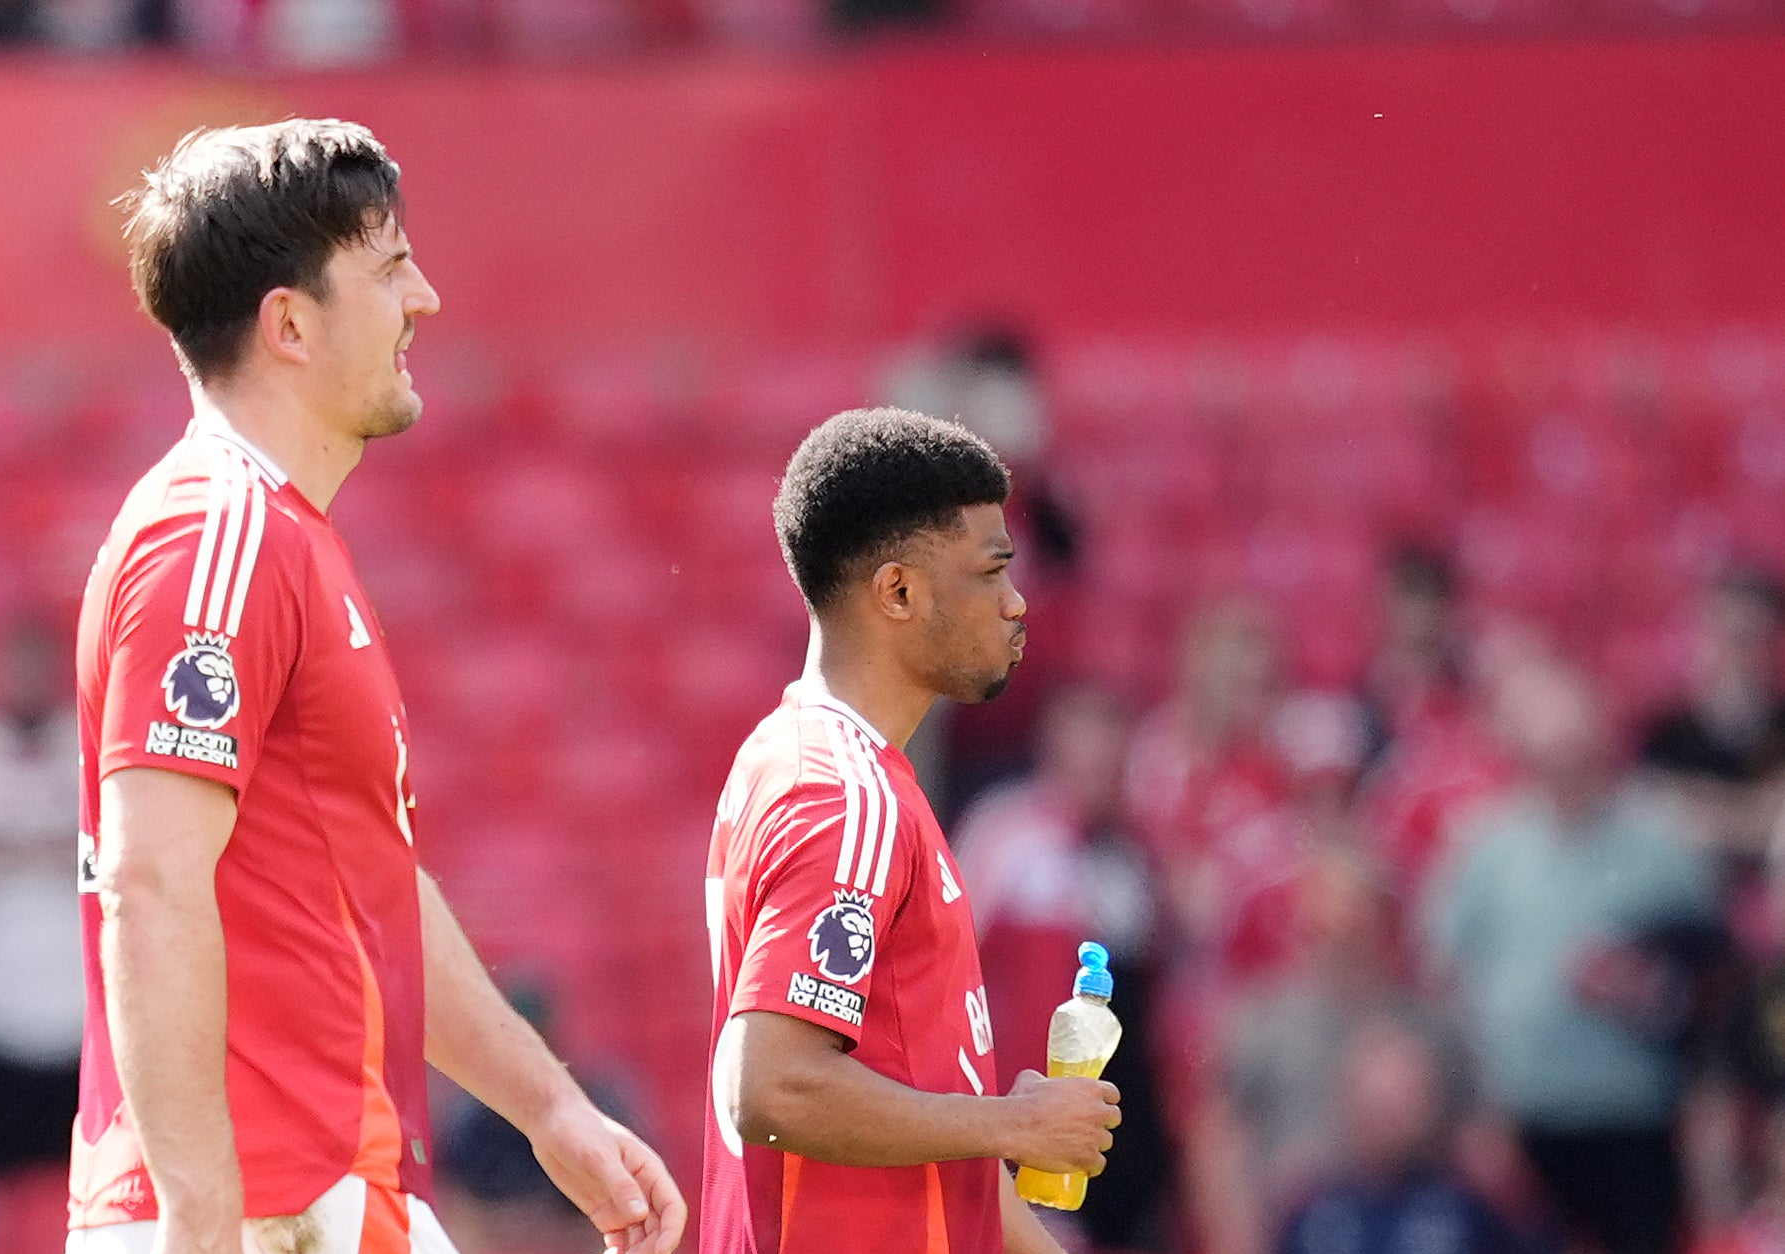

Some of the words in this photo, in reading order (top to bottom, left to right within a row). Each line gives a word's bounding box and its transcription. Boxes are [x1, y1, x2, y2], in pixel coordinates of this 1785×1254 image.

[145, 738, 176, 755] for
[176, 743, 238, 769] racism
[148, 721, 179, 742] No
[180, 728, 232, 752] room
[787, 987, 814, 1006] for
[814, 996, 862, 1026] racism
[791, 972, 818, 993] No
[818, 983, 861, 1010] room
